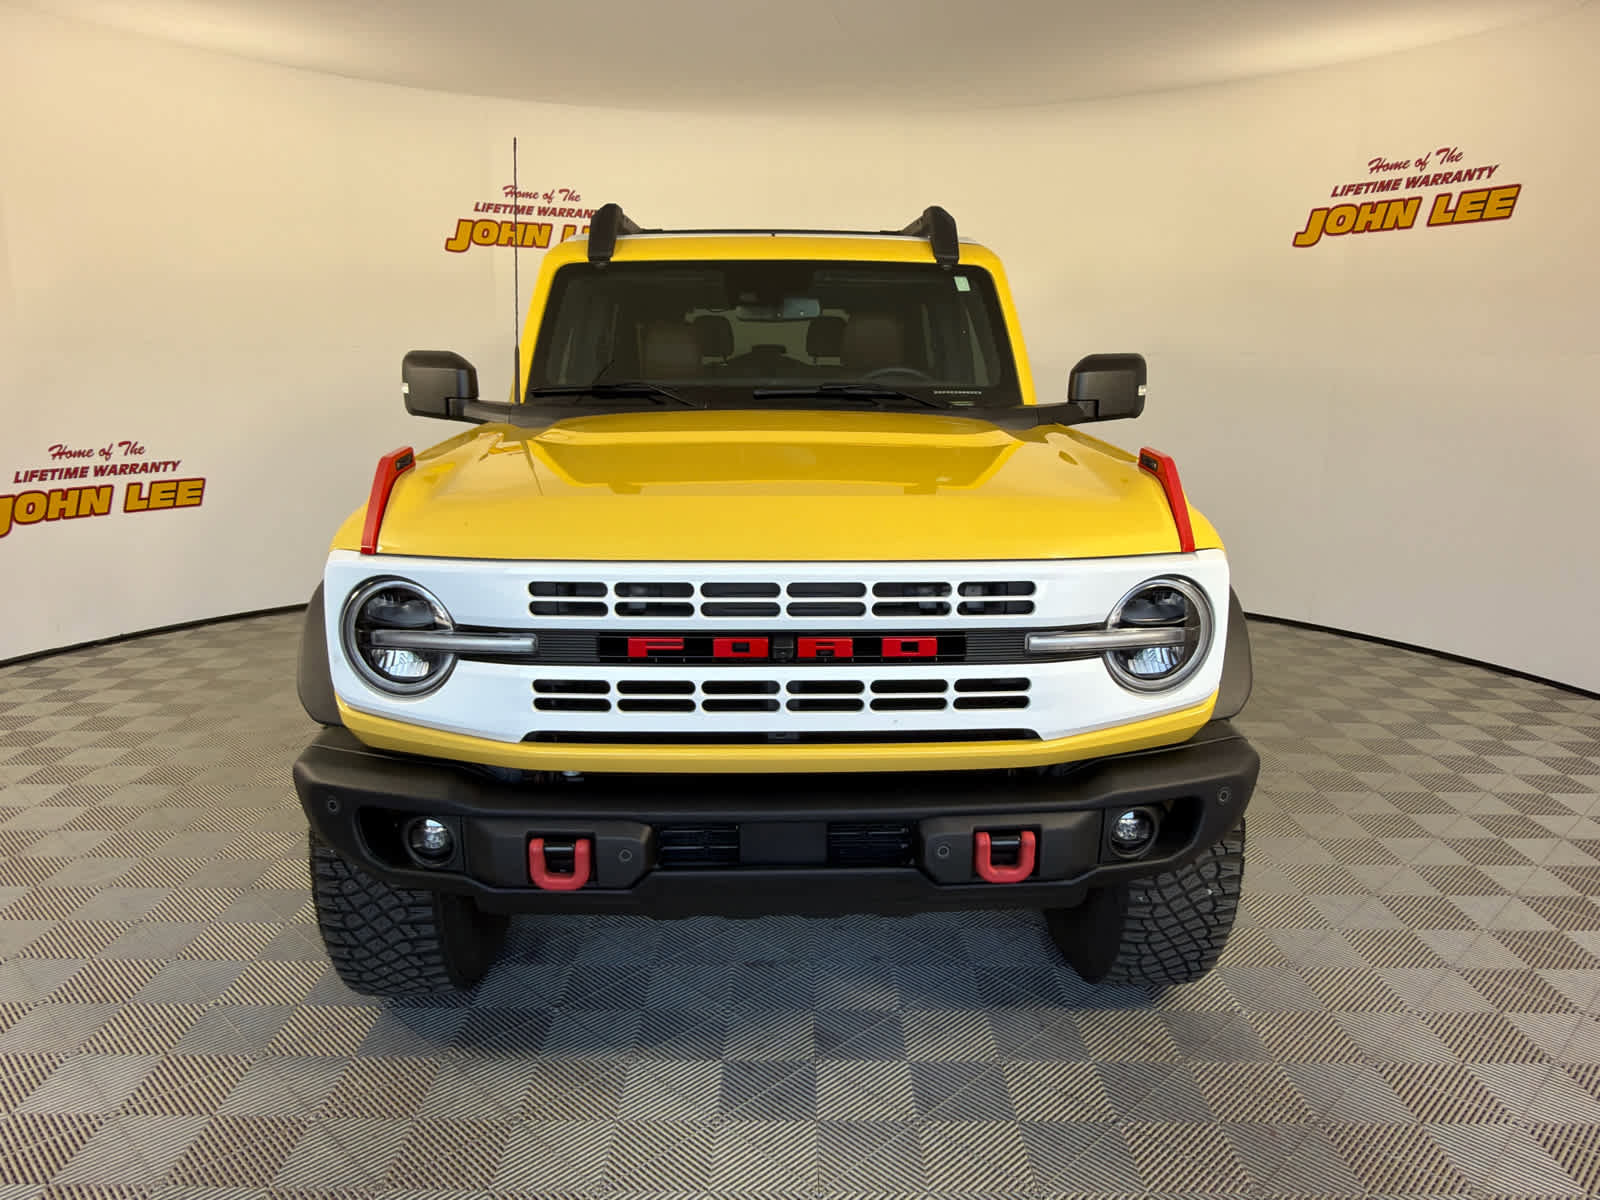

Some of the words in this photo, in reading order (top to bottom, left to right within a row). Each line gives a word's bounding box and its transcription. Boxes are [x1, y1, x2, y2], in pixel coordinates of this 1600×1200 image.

[1368, 157, 1411, 175] Home
[1414, 152, 1431, 172] of
[1436, 147, 1464, 165] The
[1331, 177, 1403, 198] LIFETIME
[1405, 164, 1499, 190] WARRANTY
[503, 185, 539, 200] Home
[542, 189, 555, 204] of
[559, 188, 581, 203] The
[474, 201, 534, 216] LIFETIME
[537, 207, 598, 220] WARRAN
[1292, 196, 1423, 248] JOHN
[1426, 184, 1522, 228] LEE
[445, 218, 552, 254] JOHN
[48, 444, 94, 461] Home
[98, 443, 114, 461] of
[118, 441, 146, 457] The
[13, 466, 89, 484] LIFETIME
[93, 460, 181, 478] WARRANTY
[123, 478, 206, 513] LEE
[627, 635, 938, 659] FORD
